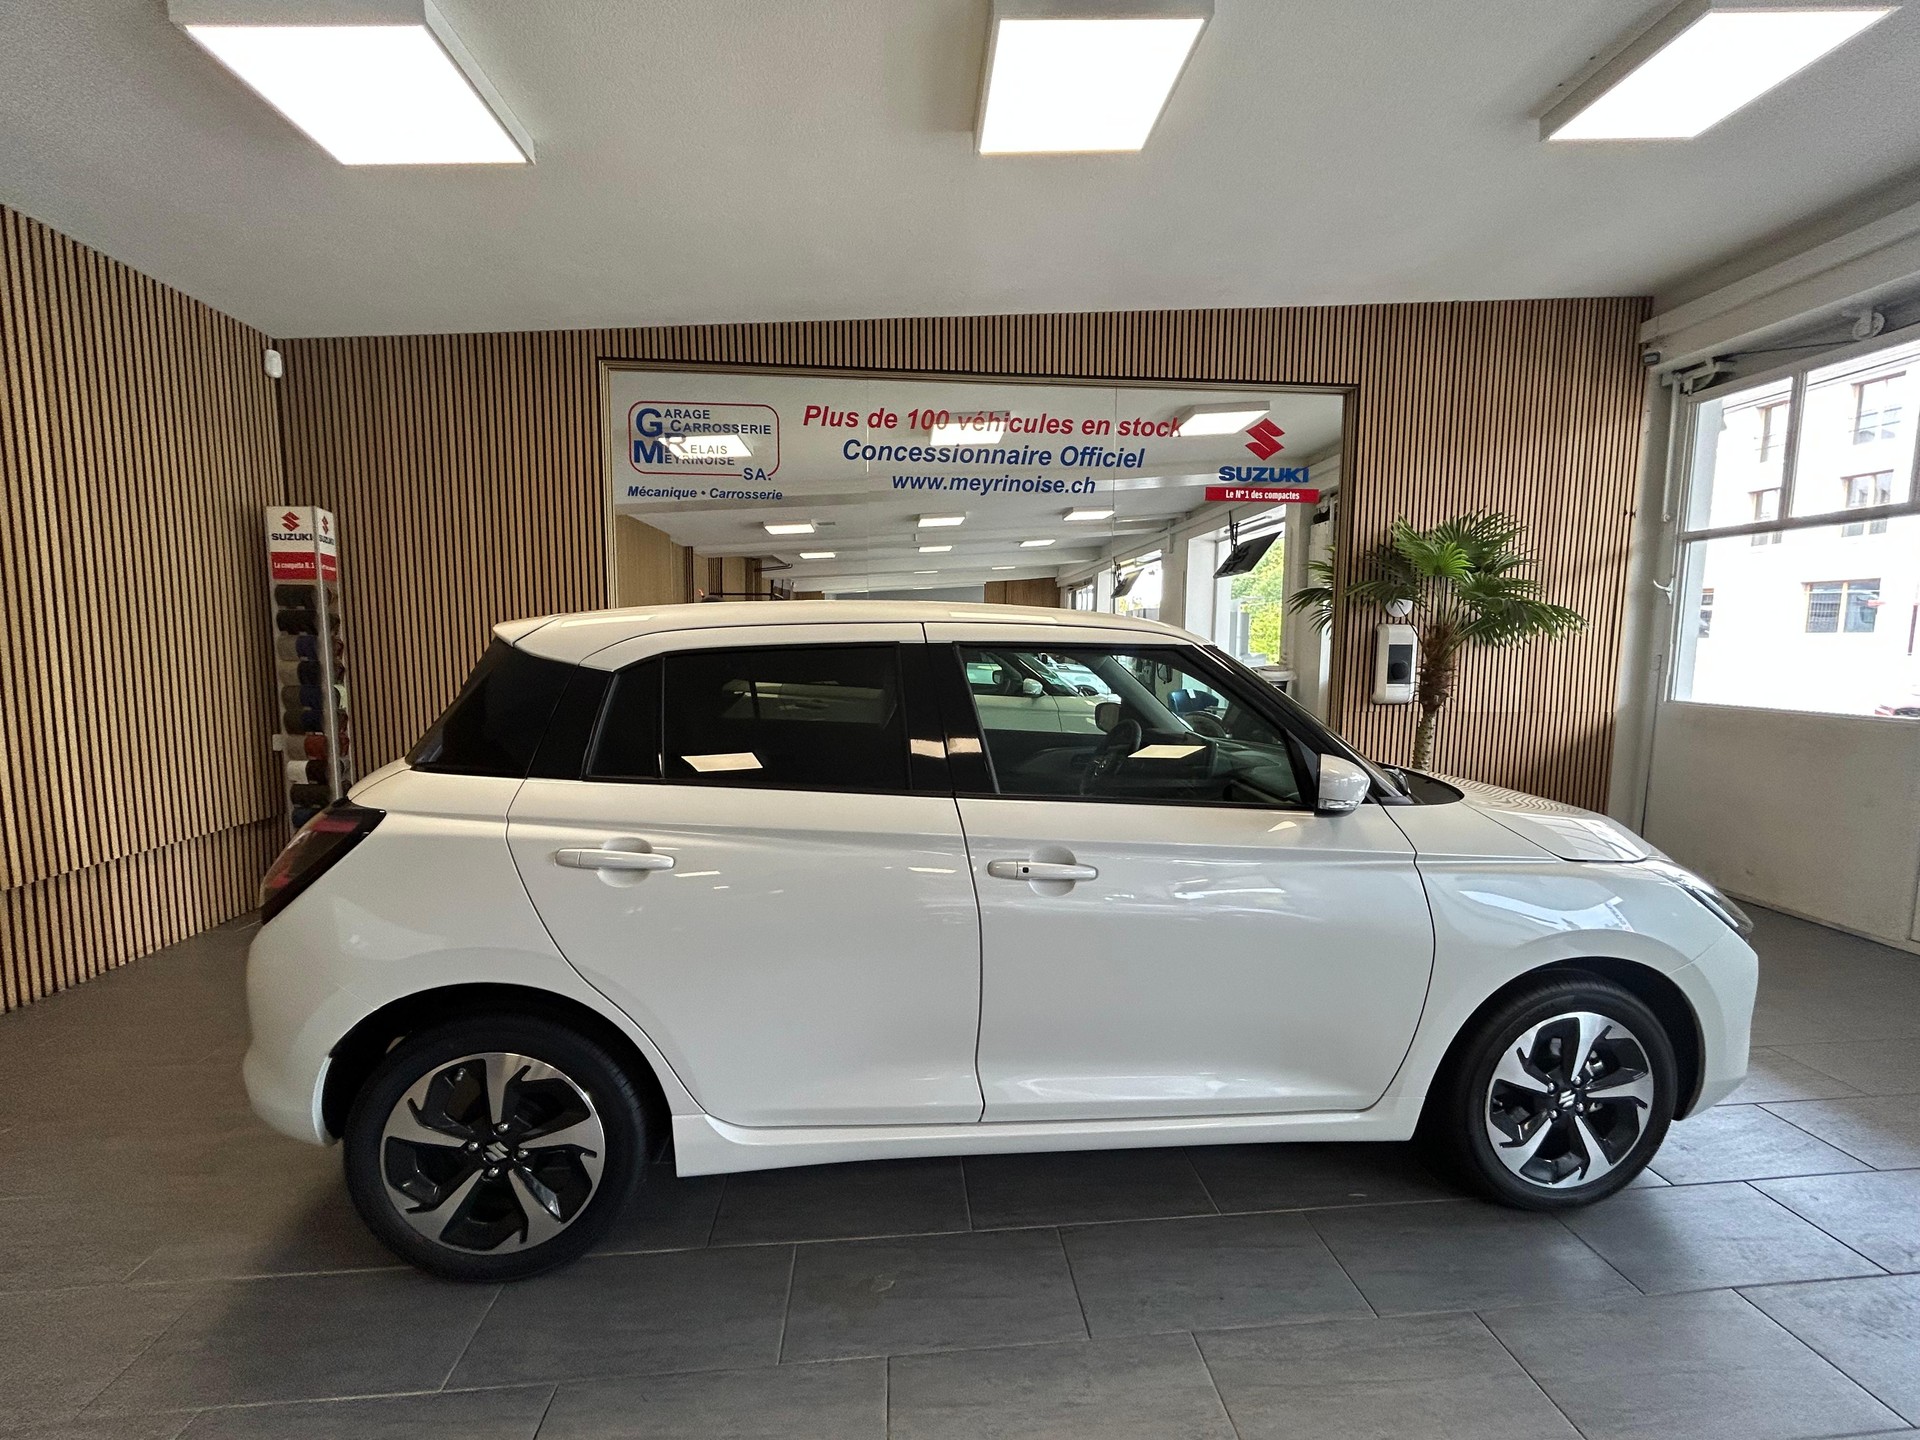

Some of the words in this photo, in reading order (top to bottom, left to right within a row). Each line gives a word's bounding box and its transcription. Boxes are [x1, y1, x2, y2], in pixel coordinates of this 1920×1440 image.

[635, 407, 711, 438] GARAGE
[670, 420, 772, 435] CARROSSERIE
[803, 405, 859, 428] Plus
[867, 408, 898, 429] de
[907, 409, 950, 431] 100
[957, 410, 1074, 435] véhicules
[1081, 417, 1111, 436] en
[1117, 417, 1182, 437] stock
[633, 440, 735, 466] MEYRINOISE
[664, 432, 728, 455] RELAIS
[843, 438, 1052, 466] Concessionnaire
[1060, 445, 1146, 468] Officiel
[1218, 466, 1310, 483] SUZUKI
[628, 485, 697, 499] Mécanique
[709, 487, 783, 500] Carrosserie
[892, 475, 1096, 496] www.meyrinoise.ch
[1225, 489, 1234, 499] Le
[1251, 489, 1263, 499] des
[1264, 490, 1300, 501] compactes
[272, 533, 313, 541] SUZUKI
